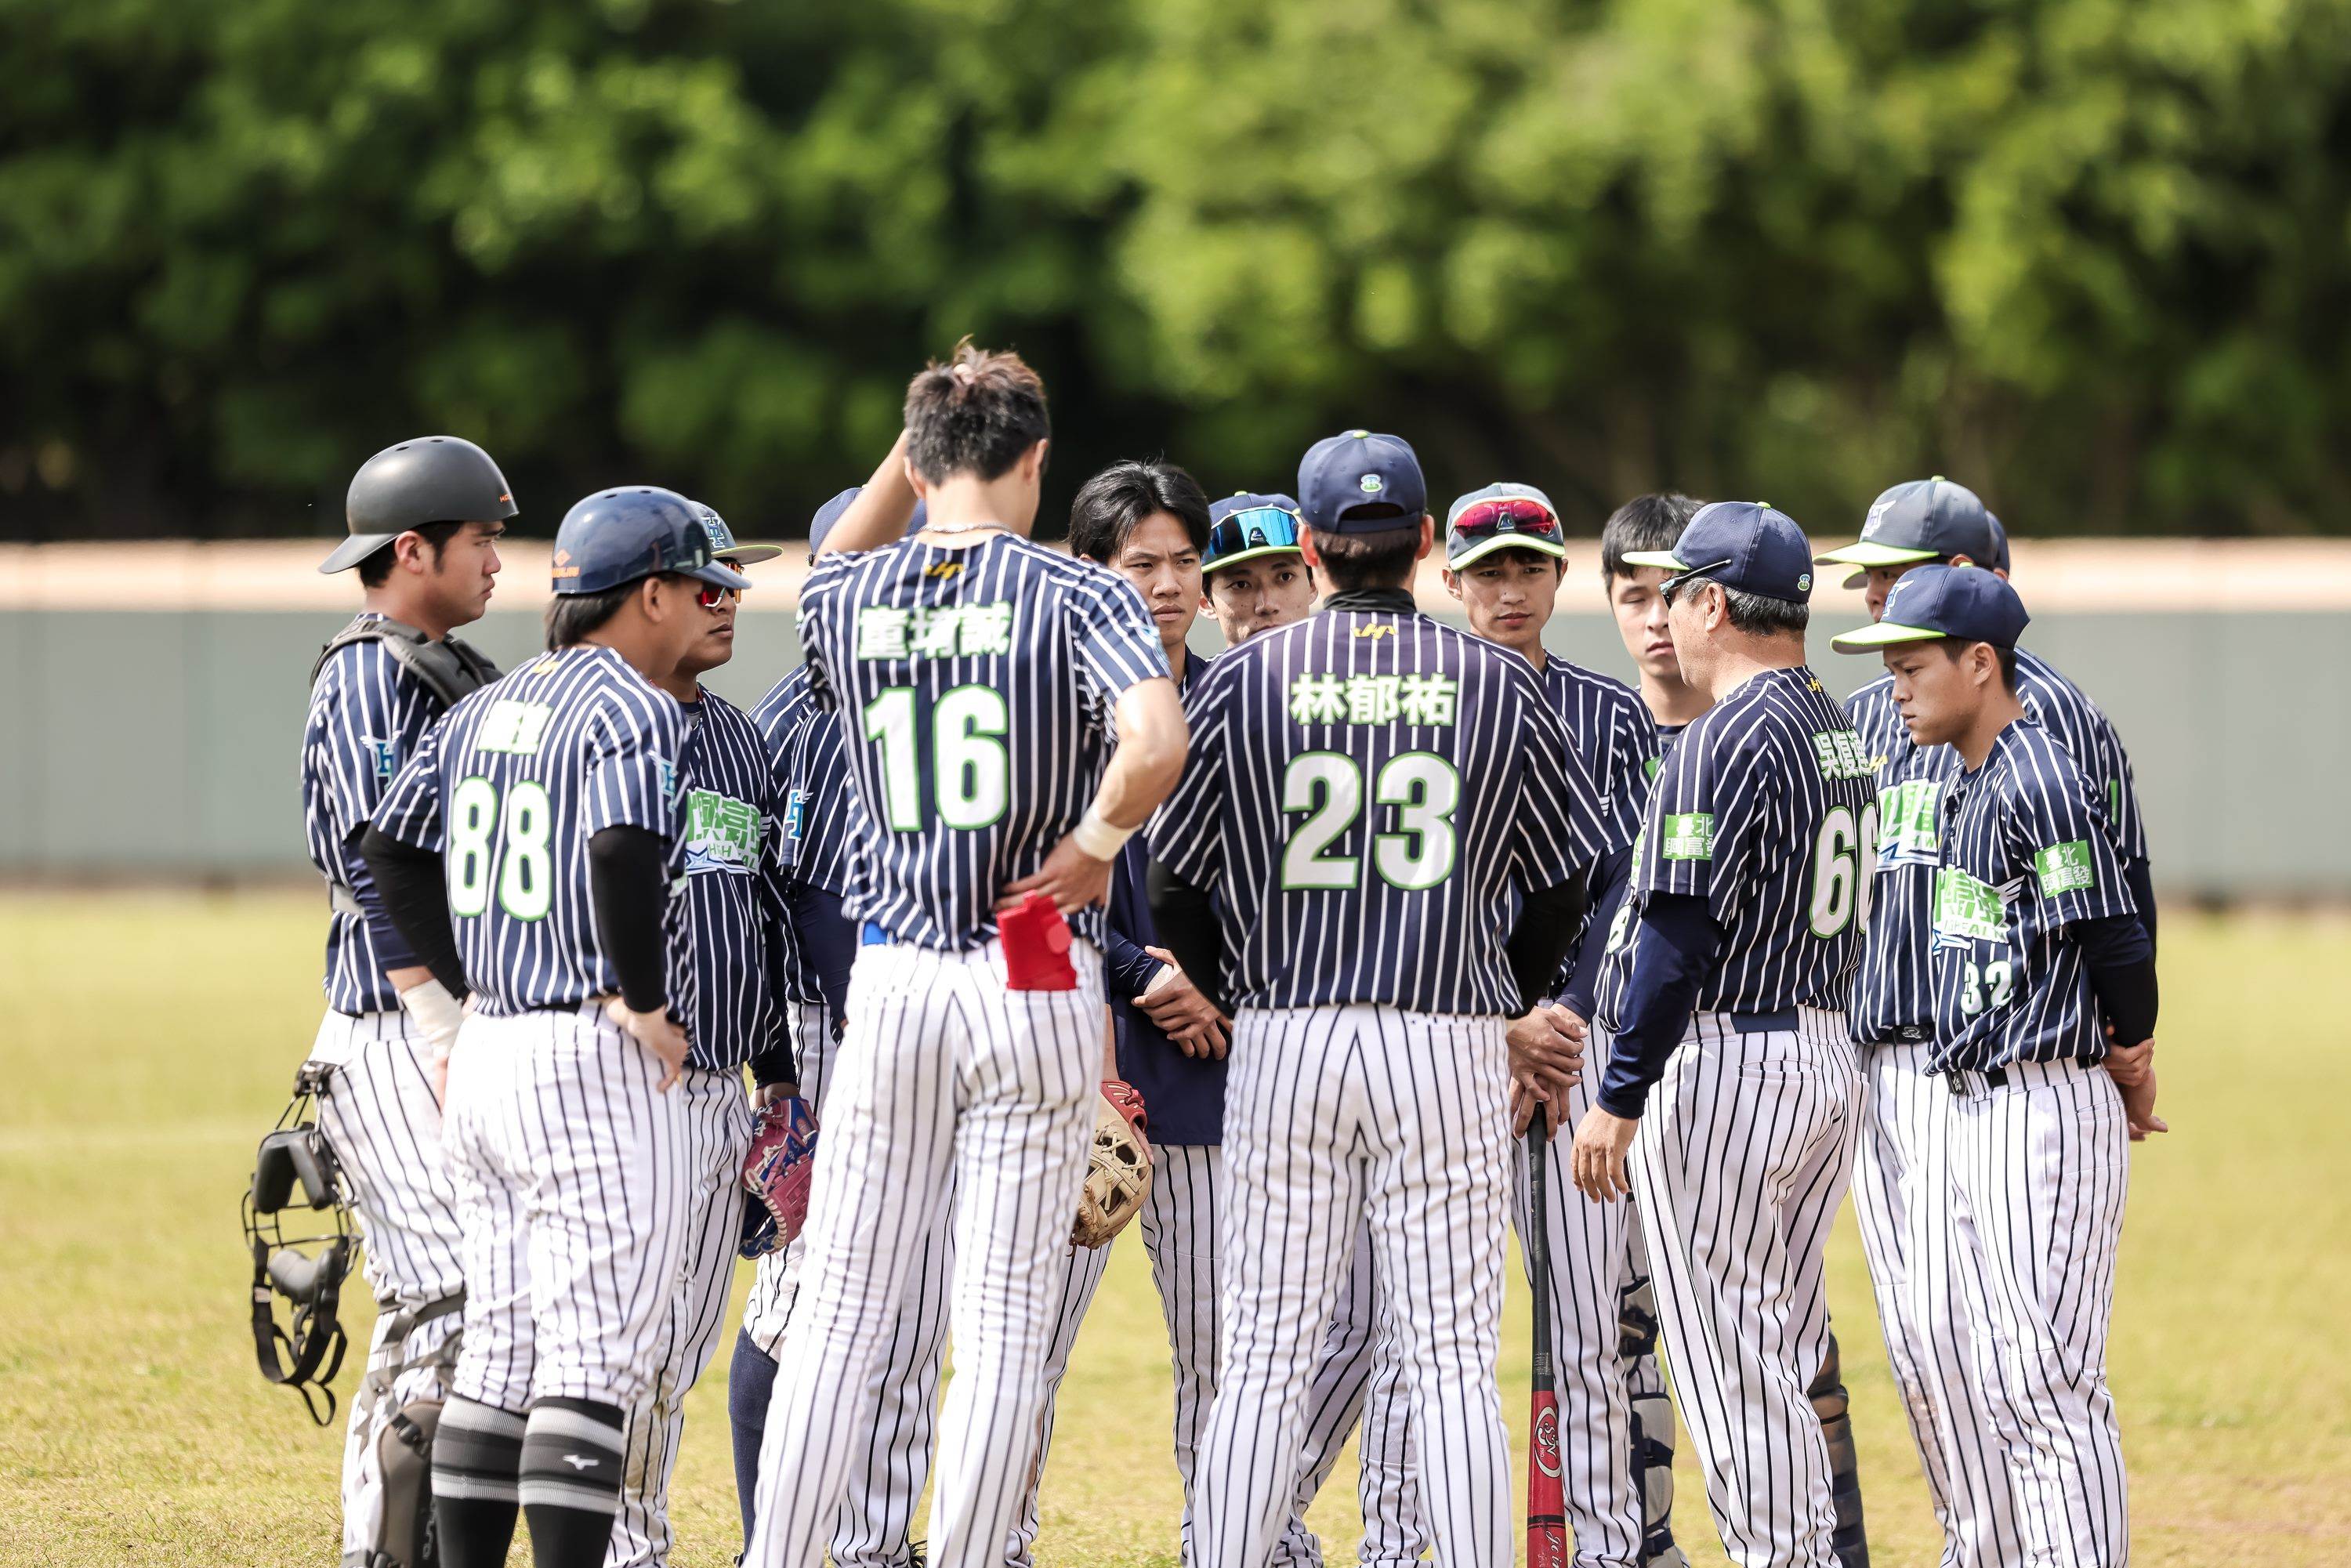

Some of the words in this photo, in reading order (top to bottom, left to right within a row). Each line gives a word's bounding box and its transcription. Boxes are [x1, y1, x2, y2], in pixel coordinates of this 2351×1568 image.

[864, 683, 1009, 831] 16
[1289, 672, 1457, 726] 林郁祐
[449, 776, 552, 922] 88
[1281, 751, 1460, 890] 23
[1809, 802, 1878, 939] 66
[1961, 960, 2013, 1015] 32
